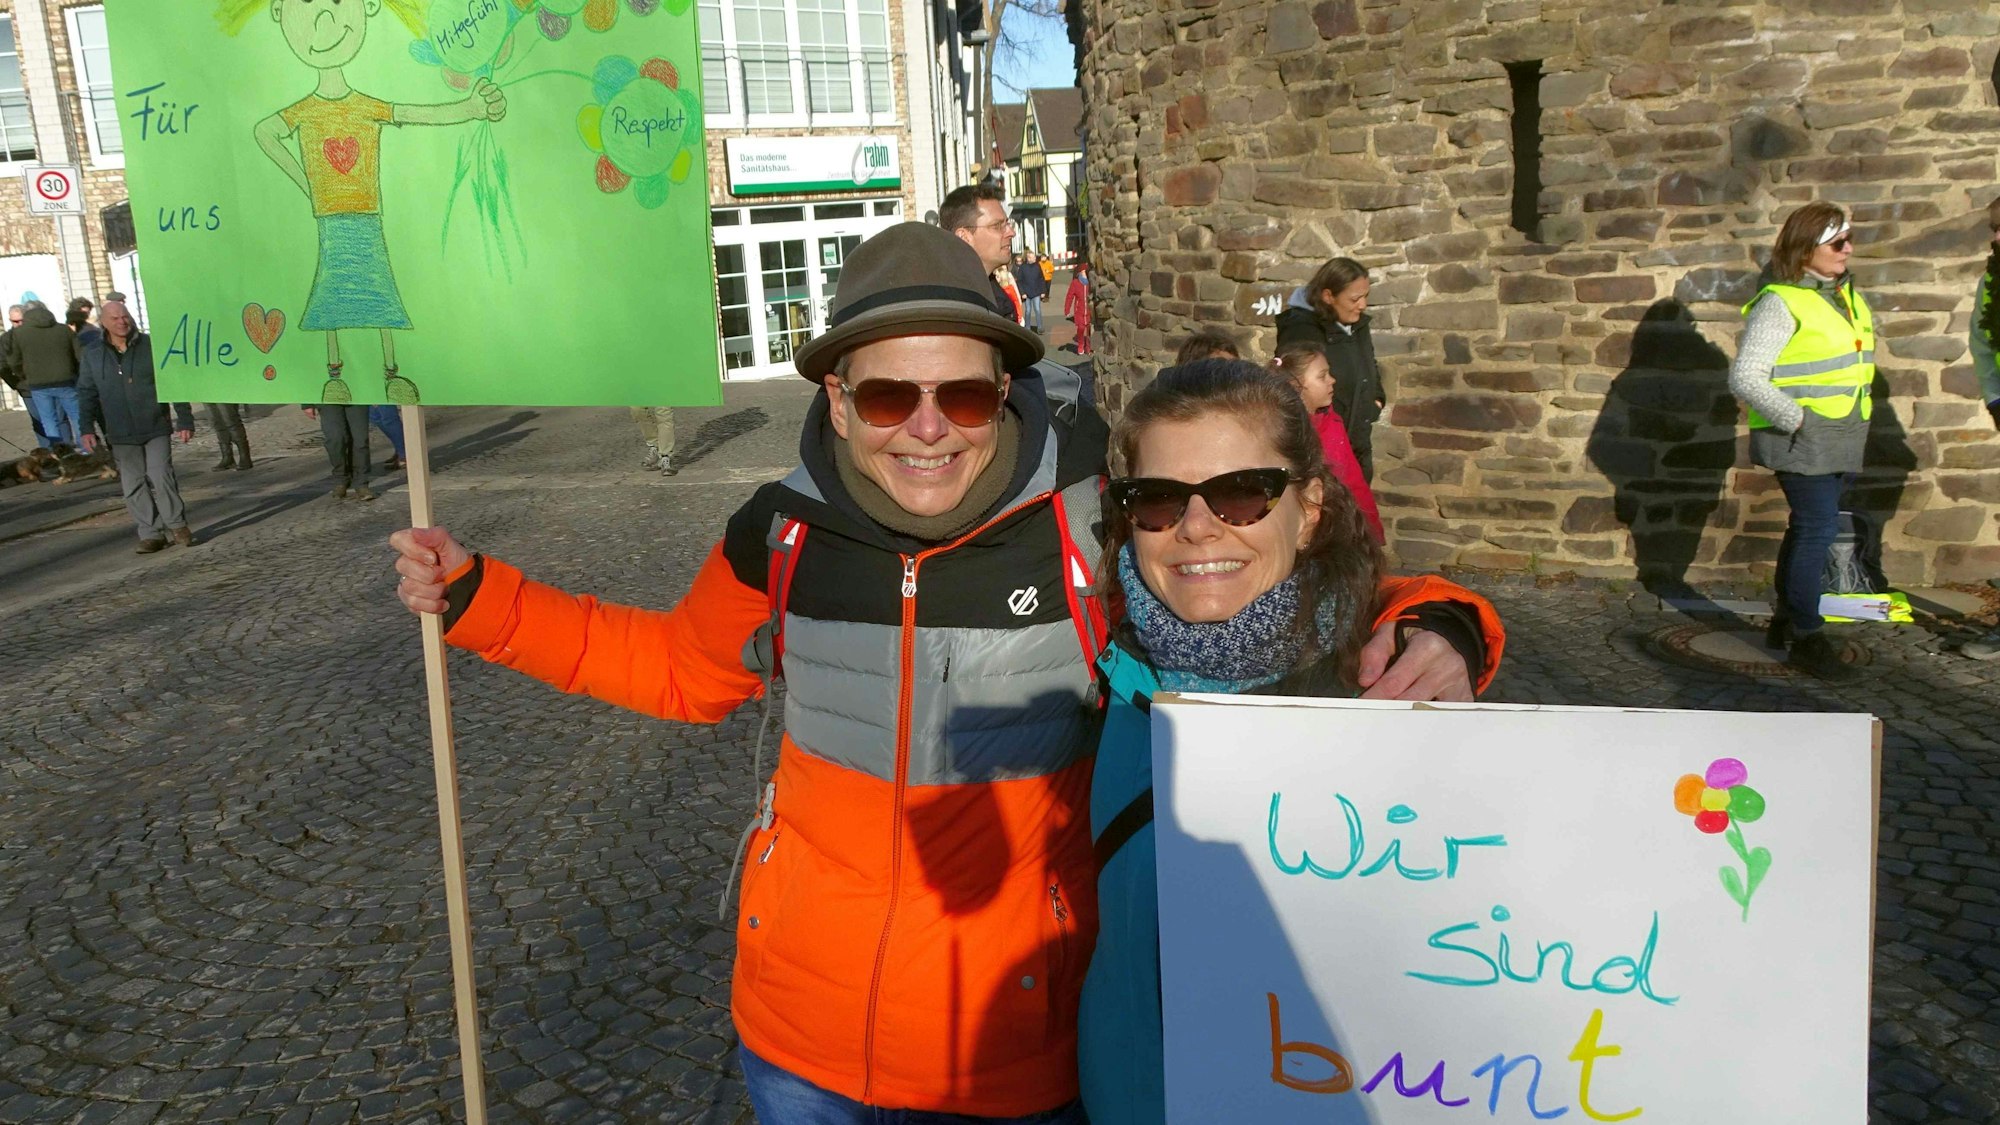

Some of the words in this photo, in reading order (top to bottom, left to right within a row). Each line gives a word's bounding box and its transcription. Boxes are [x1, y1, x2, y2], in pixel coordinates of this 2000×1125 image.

[126, 81, 200, 141] Für
[611, 105, 686, 148] Respekt
[739, 153, 754, 162] Das
[756, 153, 787, 162] moderne
[863, 141, 890, 168] rahm
[43, 178, 63, 193] 30
[43, 201, 69, 210] ZONE
[158, 205, 220, 232] uns
[160, 313, 240, 370] Alle
[1268, 792, 1507, 881] Wir
[1267, 992, 1642, 1122] bunt
